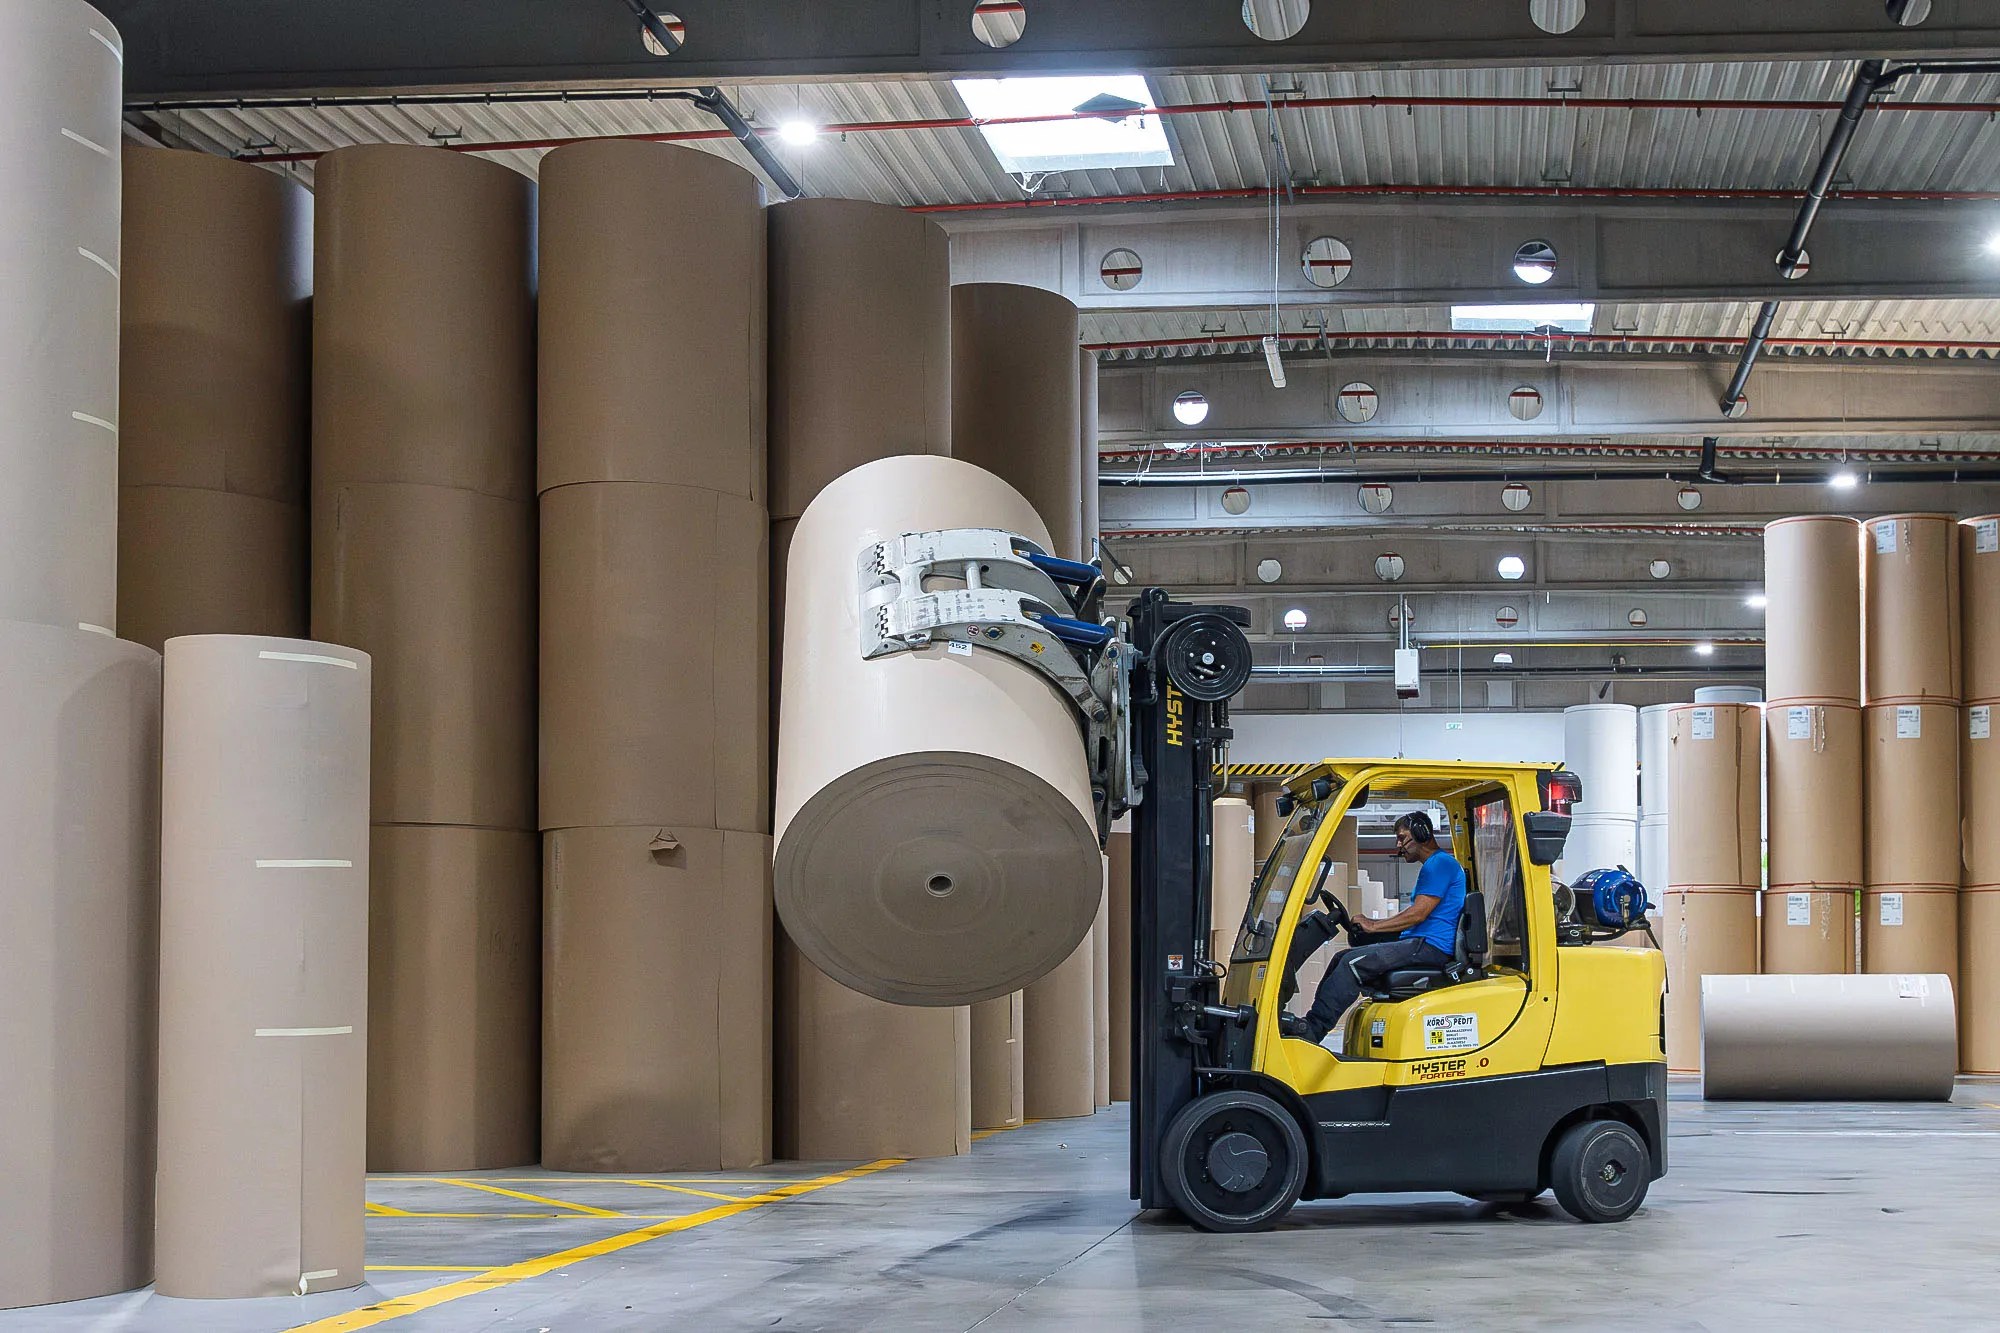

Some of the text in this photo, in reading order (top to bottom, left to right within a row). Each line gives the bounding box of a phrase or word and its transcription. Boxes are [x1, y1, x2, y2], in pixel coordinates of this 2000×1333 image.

[1167, 676, 1182, 746] HYST
[1412, 1060, 1466, 1074] HYSTER
[1420, 1070, 1466, 1080] FORTENS
